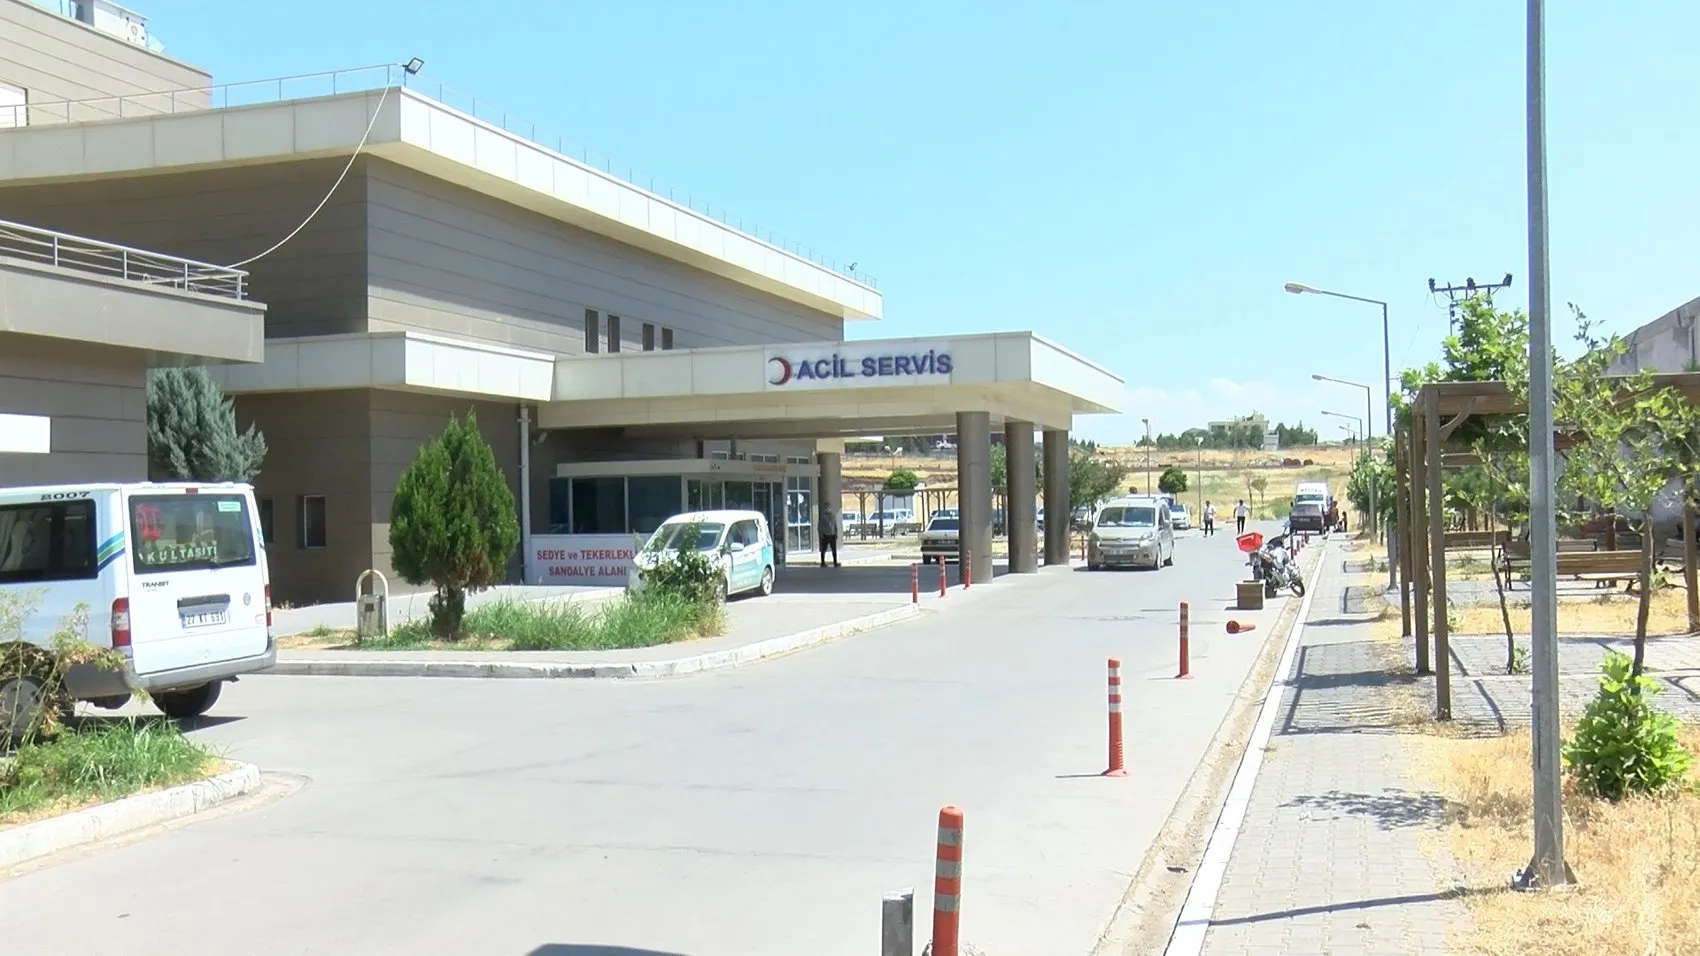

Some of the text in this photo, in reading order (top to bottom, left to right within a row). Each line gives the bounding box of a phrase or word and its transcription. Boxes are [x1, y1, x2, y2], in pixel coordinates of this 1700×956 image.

[797, 349, 953, 380] ACİL SERVİS
[537, 549, 565, 560] SEDYE
[567, 552, 578, 560] ve
[549, 566, 627, 577] SANDALYE ALANI
